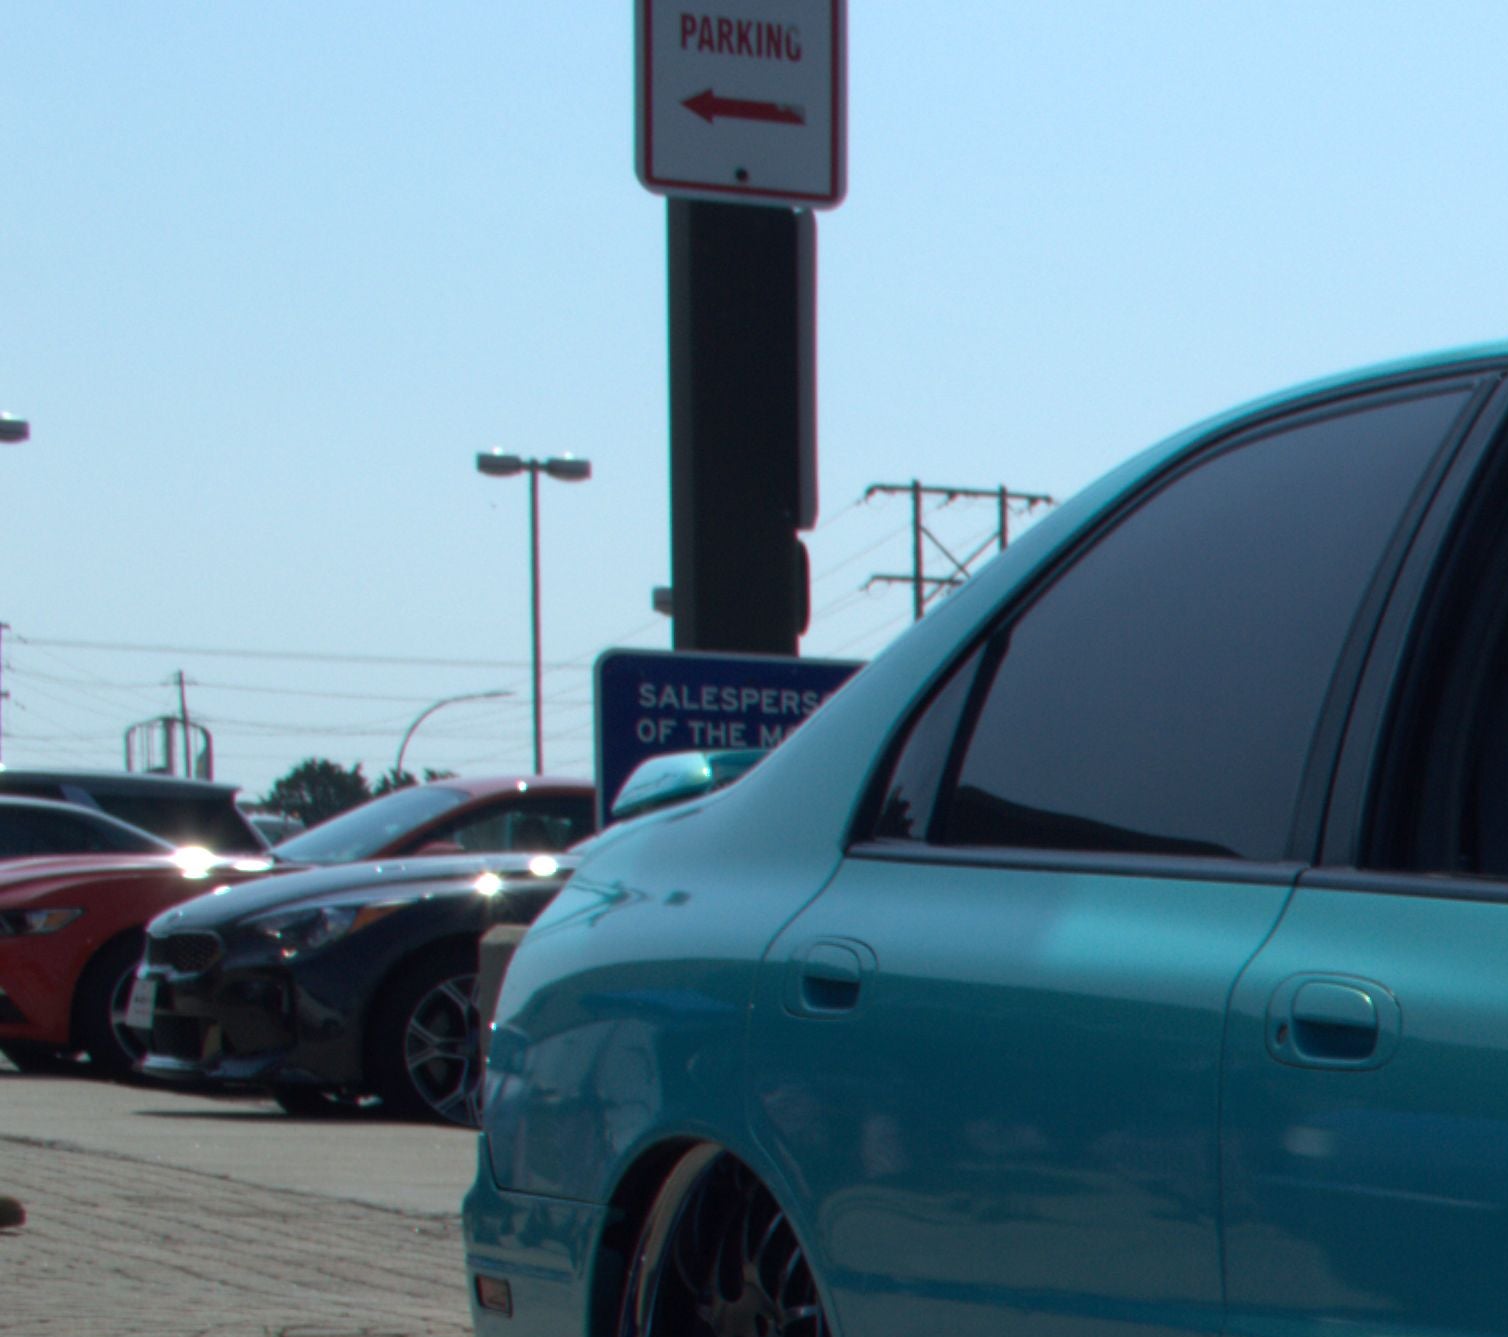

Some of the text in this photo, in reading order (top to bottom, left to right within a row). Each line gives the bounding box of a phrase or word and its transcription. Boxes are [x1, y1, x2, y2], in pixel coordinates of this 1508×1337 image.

[680, 13, 802, 62] PARKING
[637, 718, 677, 745] OF
[687, 720, 746, 748] THE
